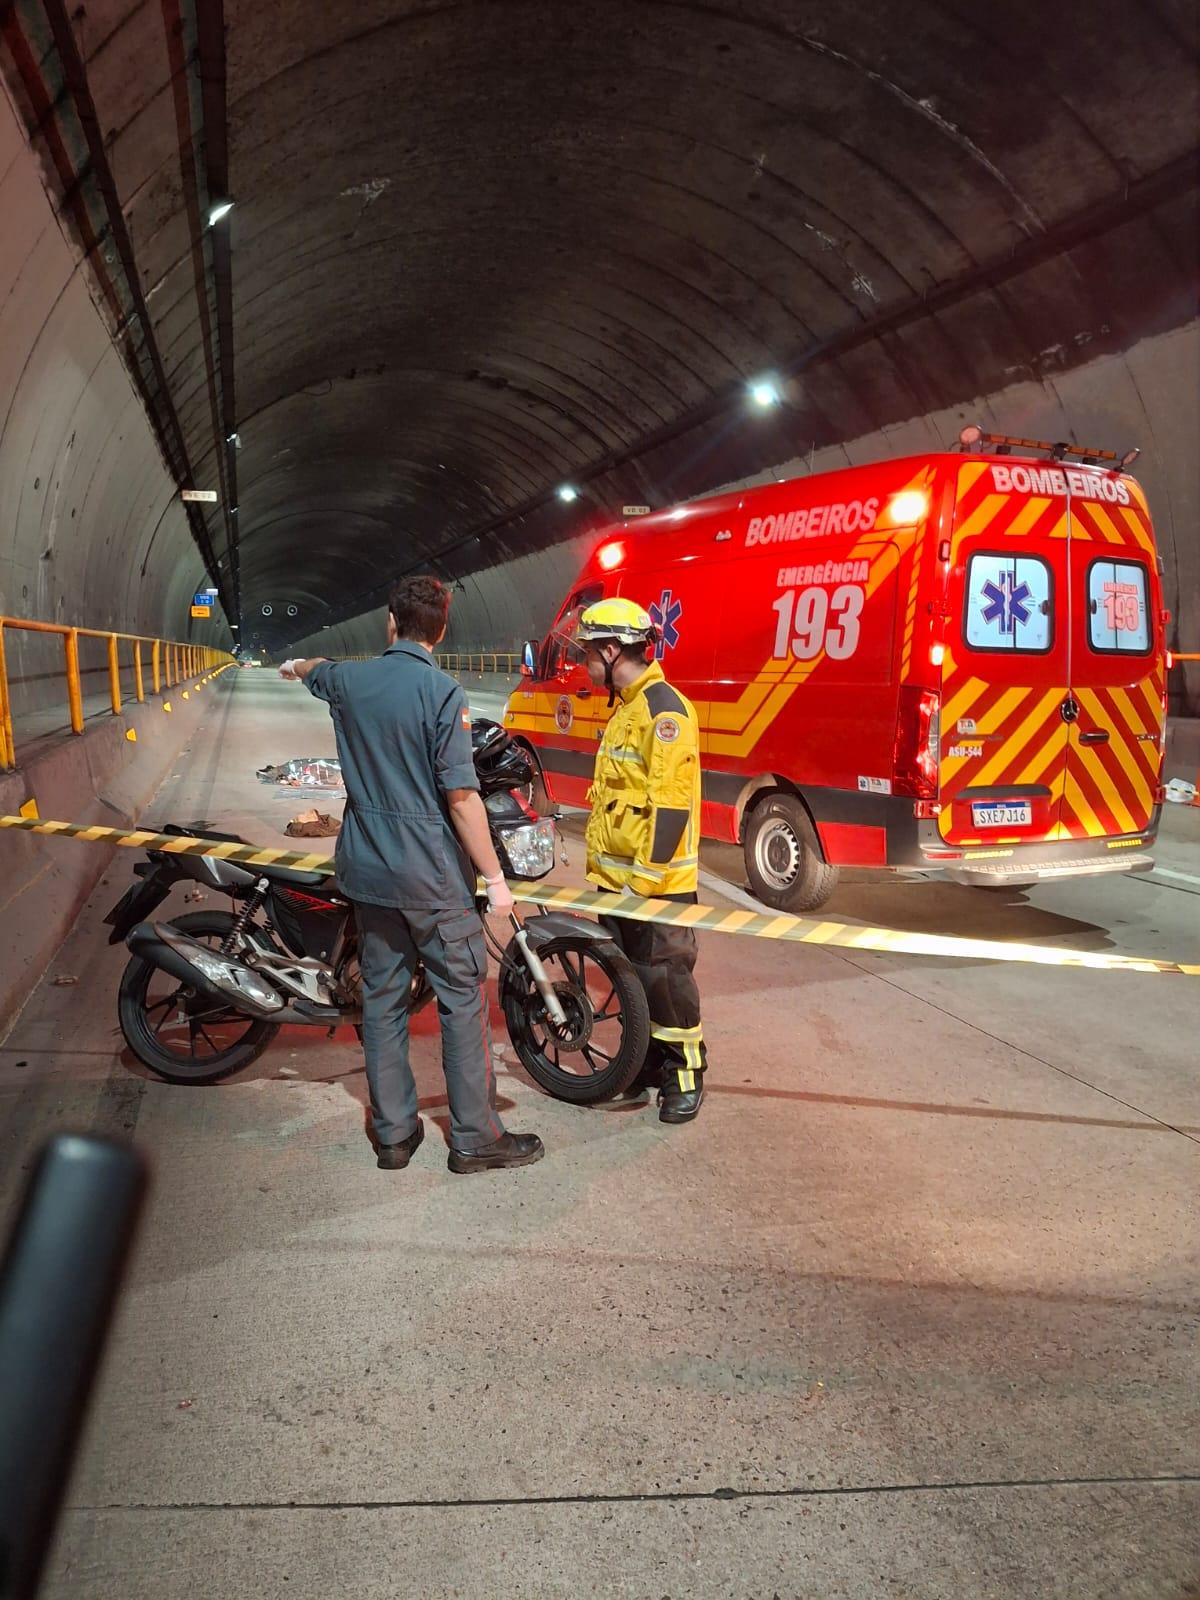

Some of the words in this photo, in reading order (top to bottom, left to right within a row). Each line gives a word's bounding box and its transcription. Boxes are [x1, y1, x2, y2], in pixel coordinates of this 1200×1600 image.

[991, 465, 1130, 505] BOMBEIROS
[744, 497, 879, 547] BOMBEIROS
[776, 560, 870, 587] EMERGÊNCIA
[771, 585, 865, 661] 193
[1103, 595, 1139, 631] 193
[979, 809, 1026, 824] SXE7J16
